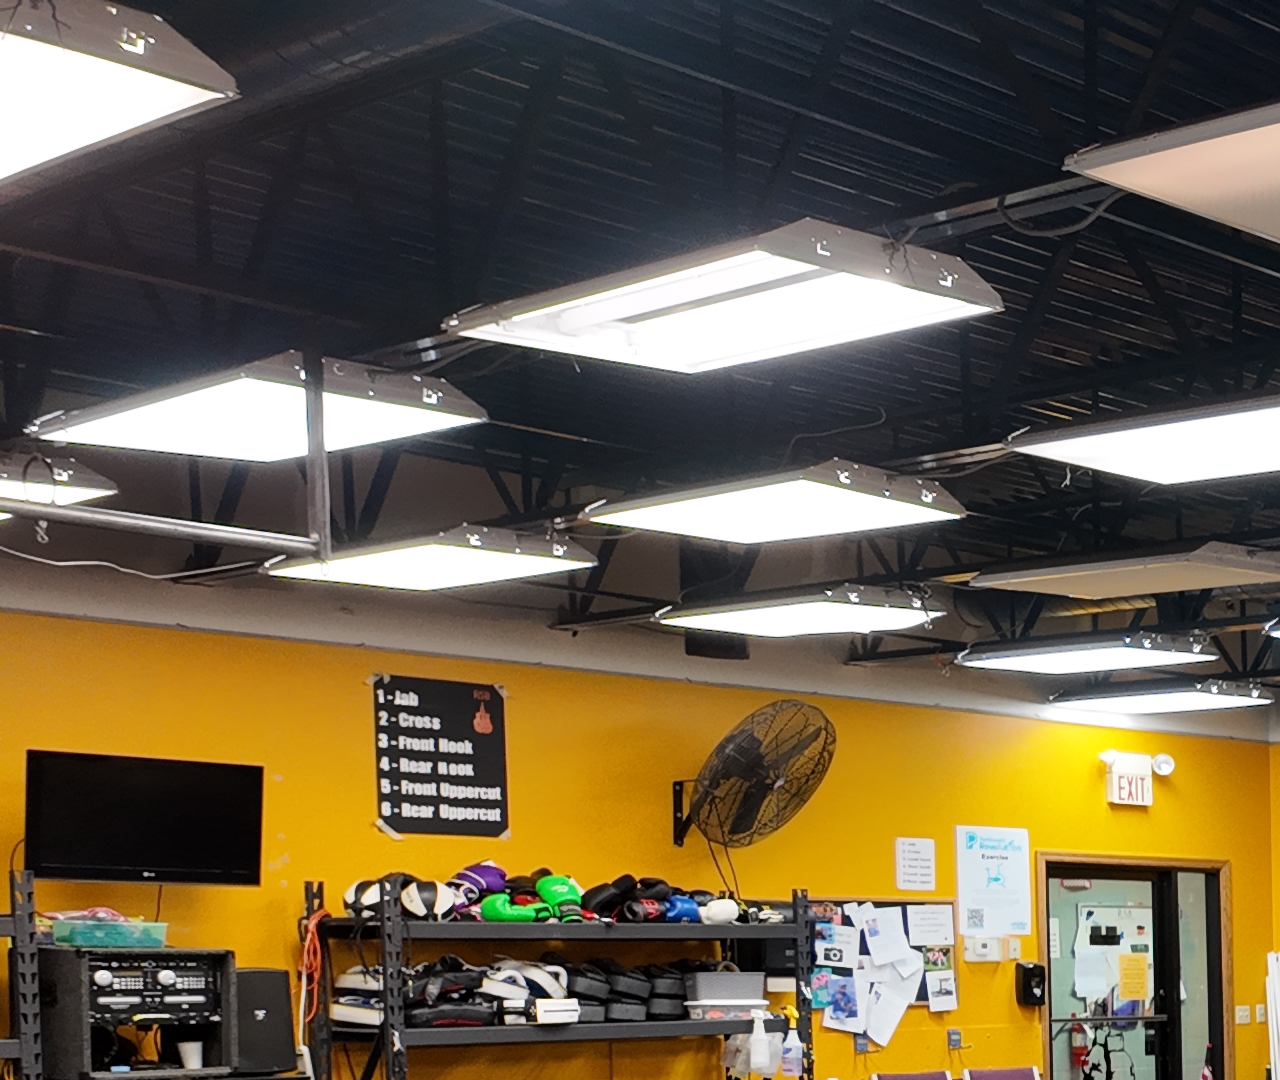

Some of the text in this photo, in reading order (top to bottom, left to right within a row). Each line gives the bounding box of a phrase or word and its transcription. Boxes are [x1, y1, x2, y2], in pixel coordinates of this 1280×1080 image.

[398, 712, 441, 730] Cross
[398, 735, 435, 751] Front
[438, 738, 474, 755] Hook
[400, 780, 438, 796] Front
[440, 782, 502, 800] Uppercut
[1118, 775, 1145, 802] EXIT
[439, 804, 501, 821] Uppercut
